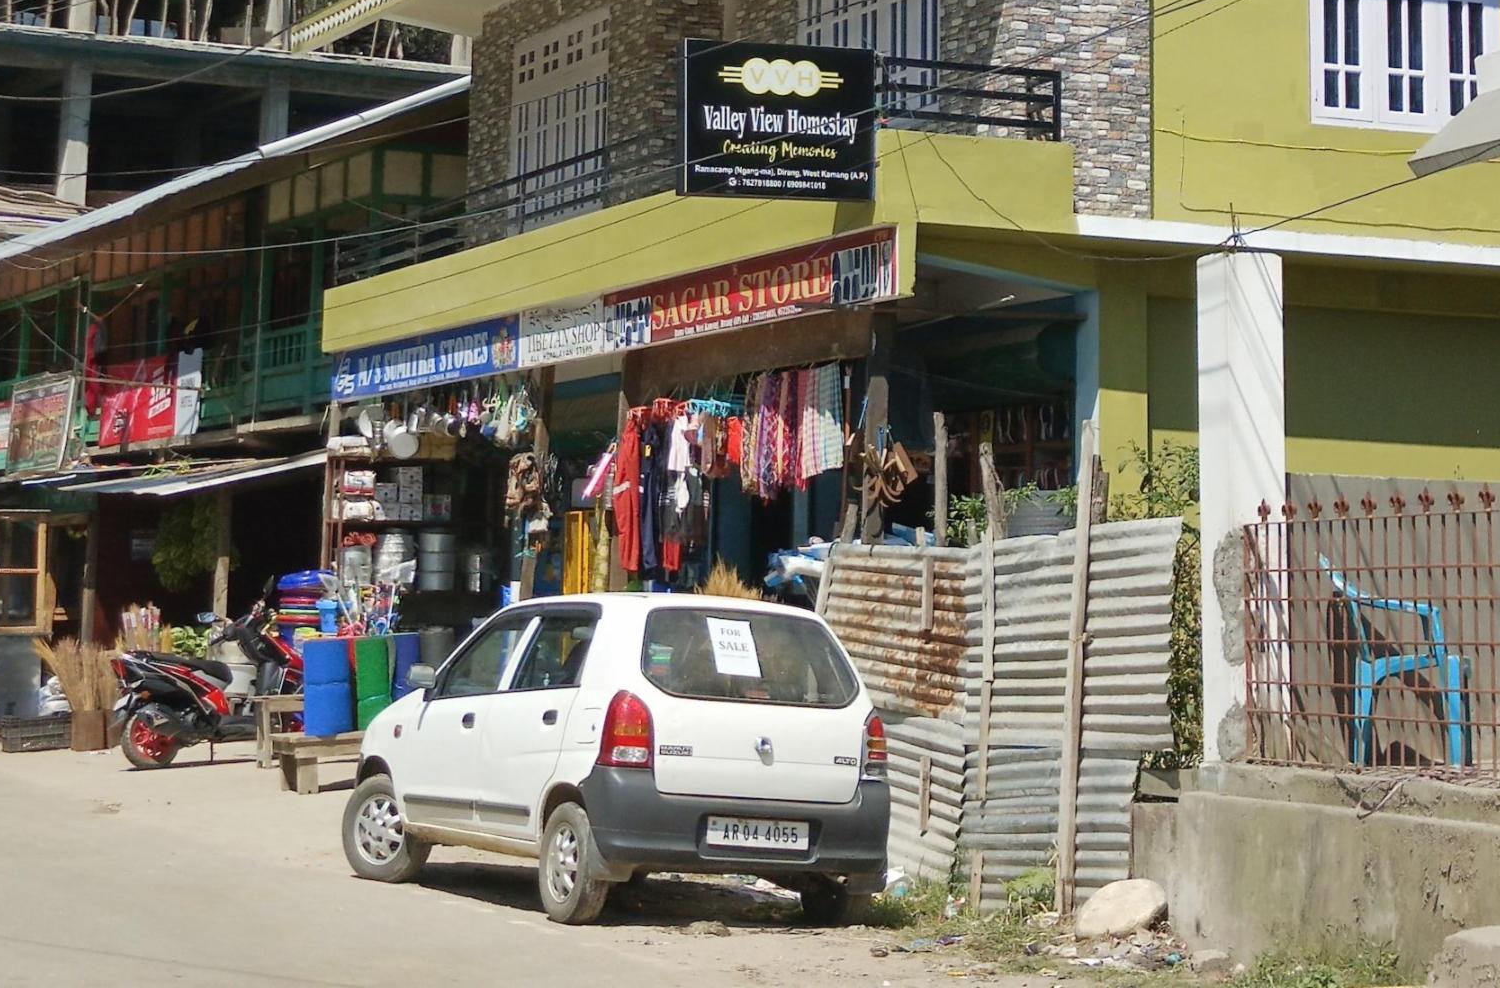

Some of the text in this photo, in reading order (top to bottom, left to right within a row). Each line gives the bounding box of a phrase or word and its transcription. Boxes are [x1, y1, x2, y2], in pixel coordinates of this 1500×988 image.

[703, 105, 858, 144] Valley View Homestay
[723, 139, 837, 162] Creating Memories
[694, 164, 734, 176] Ramacamp
[802, 169, 820, 179] West
[651, 279, 732, 330] SAGAR
[738, 257, 832, 312] STORE
[527, 322, 600, 354] TIBETAN SHOP
[383, 342, 436, 383] SUMITRA
[439, 331, 489, 373] STORES
[720, 627, 742, 638] FOR
[718, 640, 750, 653] SALE
[835, 757, 857, 765] ALTO
[764, 825, 799, 843] 4055
